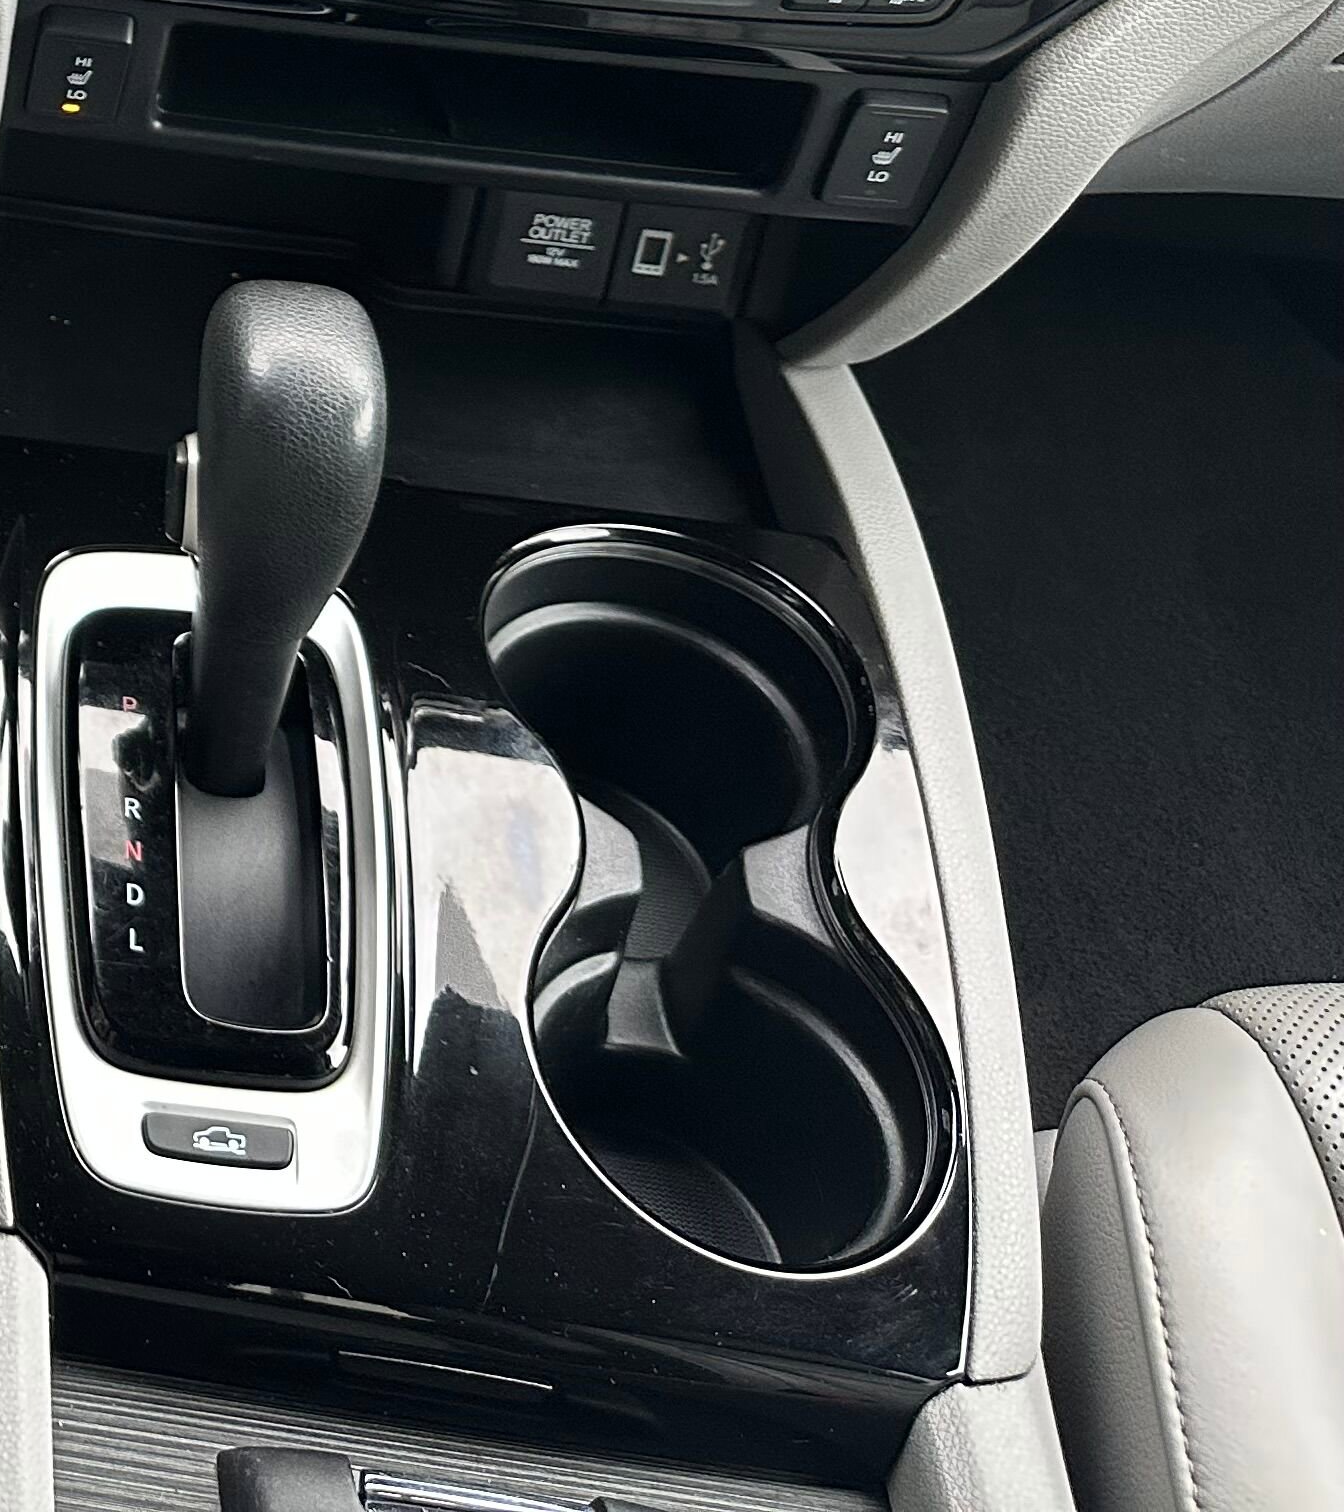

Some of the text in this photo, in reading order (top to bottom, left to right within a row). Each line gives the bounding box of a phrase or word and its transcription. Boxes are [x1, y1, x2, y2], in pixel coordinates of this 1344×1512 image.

[74, 56, 93, 67] HI
[66, 89, 88, 100] LO
[883, 131, 904, 144] HI
[867, 170, 890, 183] LO
[533, 213, 593, 231] POWER
[527, 225, 592, 244] OUTLET
[122, 695, 138, 712] P
[124, 797, 142, 820] R
[124, 841, 143, 862] N
[126, 883, 145, 906] D
[129, 928, 144, 953] L
